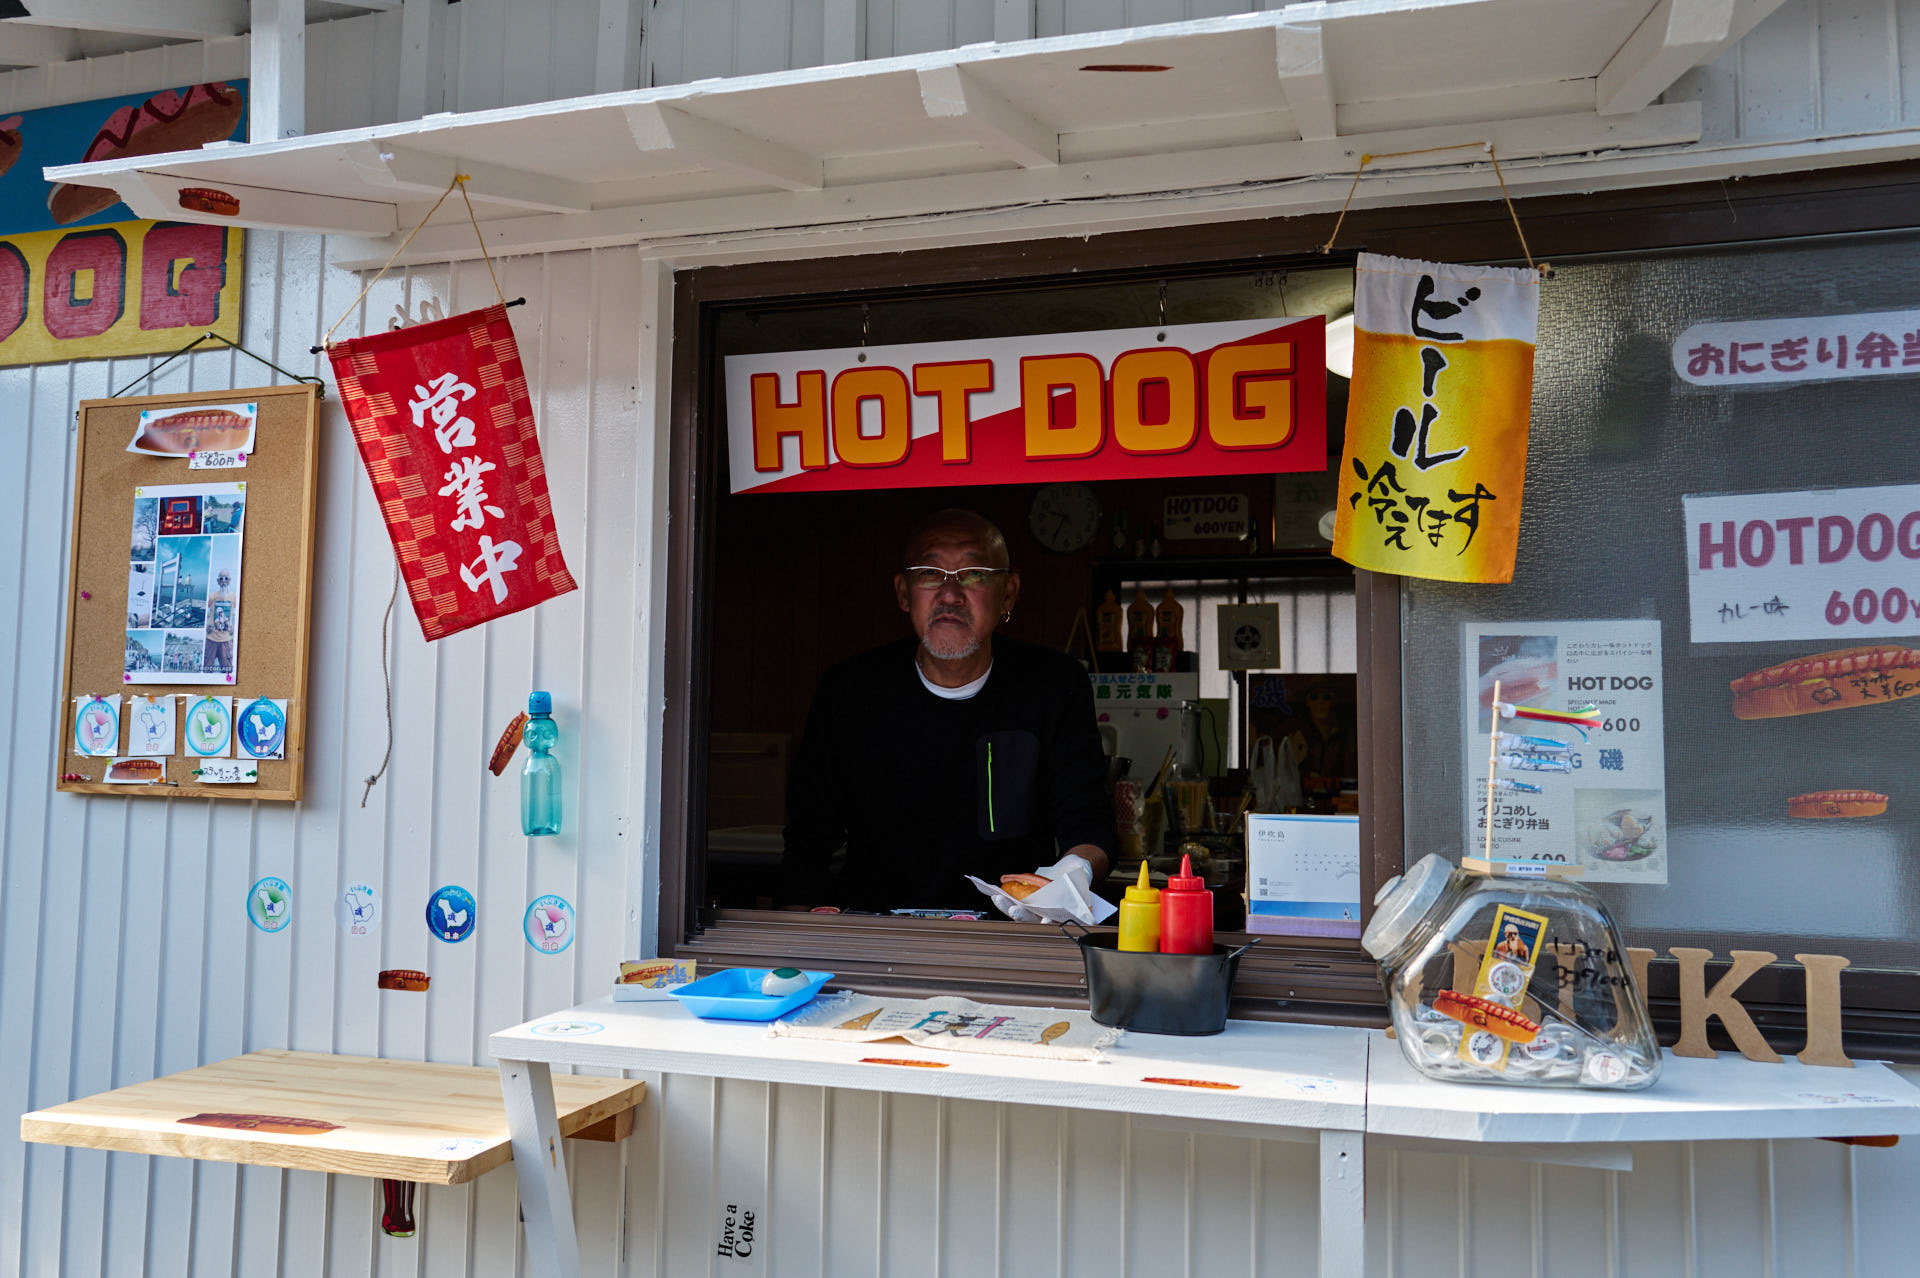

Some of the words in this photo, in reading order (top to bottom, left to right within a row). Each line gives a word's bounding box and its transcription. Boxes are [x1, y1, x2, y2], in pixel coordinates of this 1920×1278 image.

[1390, 274, 1480, 470] ビール
[751, 359, 994, 473] HOT
[1019, 341, 1297, 461] DOG
[205, 456, 234, 466] 600円
[408, 372, 523, 605] 営業中
[1167, 497, 1239, 515] HOTDOG
[1350, 457, 1497, 556] 冷えてます
[1194, 521, 1246, 535] 600YEN
[1699, 511, 1920, 570] HOTDOG
[1568, 676, 1606, 691] HOT
[1610, 676, 1654, 691] DOG
[1602, 718, 1641, 732] 600
[726, 1204, 738, 1214] a
[718, 1217, 736, 1258] Have
[734, 1211, 755, 1258] Coke
